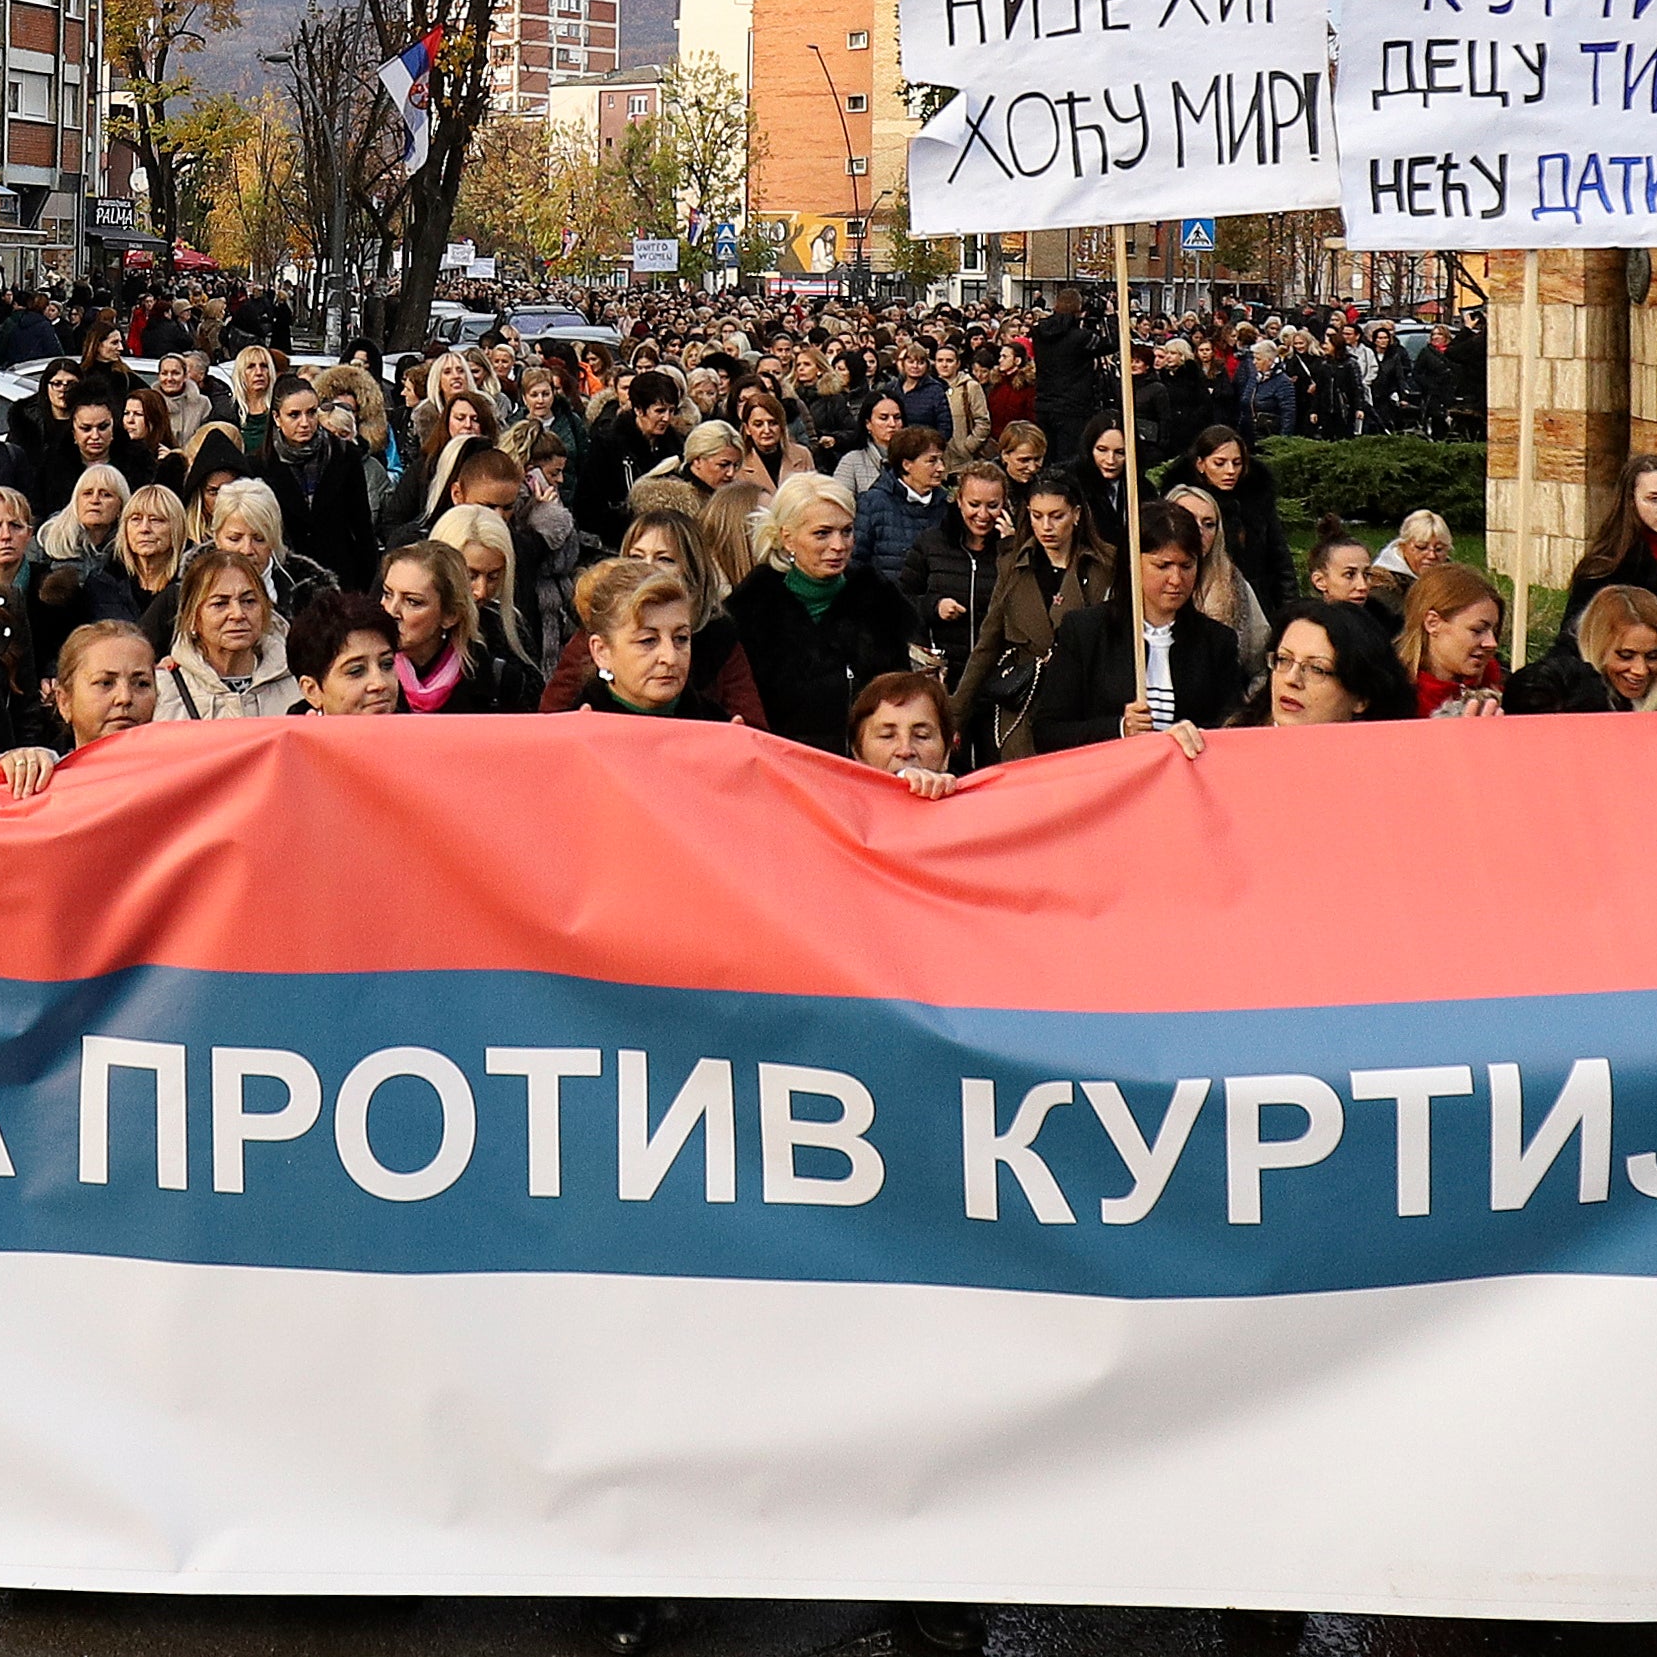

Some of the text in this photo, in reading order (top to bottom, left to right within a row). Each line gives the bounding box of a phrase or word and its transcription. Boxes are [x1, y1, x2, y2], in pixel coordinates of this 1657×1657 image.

[1371, 38, 1547, 111] ДЕЦУ
[948, 70, 1321, 184] ХОЋУ МИР!
[96, 207, 133, 226] PALMA
[1371, 152, 1507, 218] НЕЋУ
[636, 243, 668, 252] UNITED
[638, 252, 673, 261] WOMEN
[77, 1034, 887, 1207] ПРОТИВ
